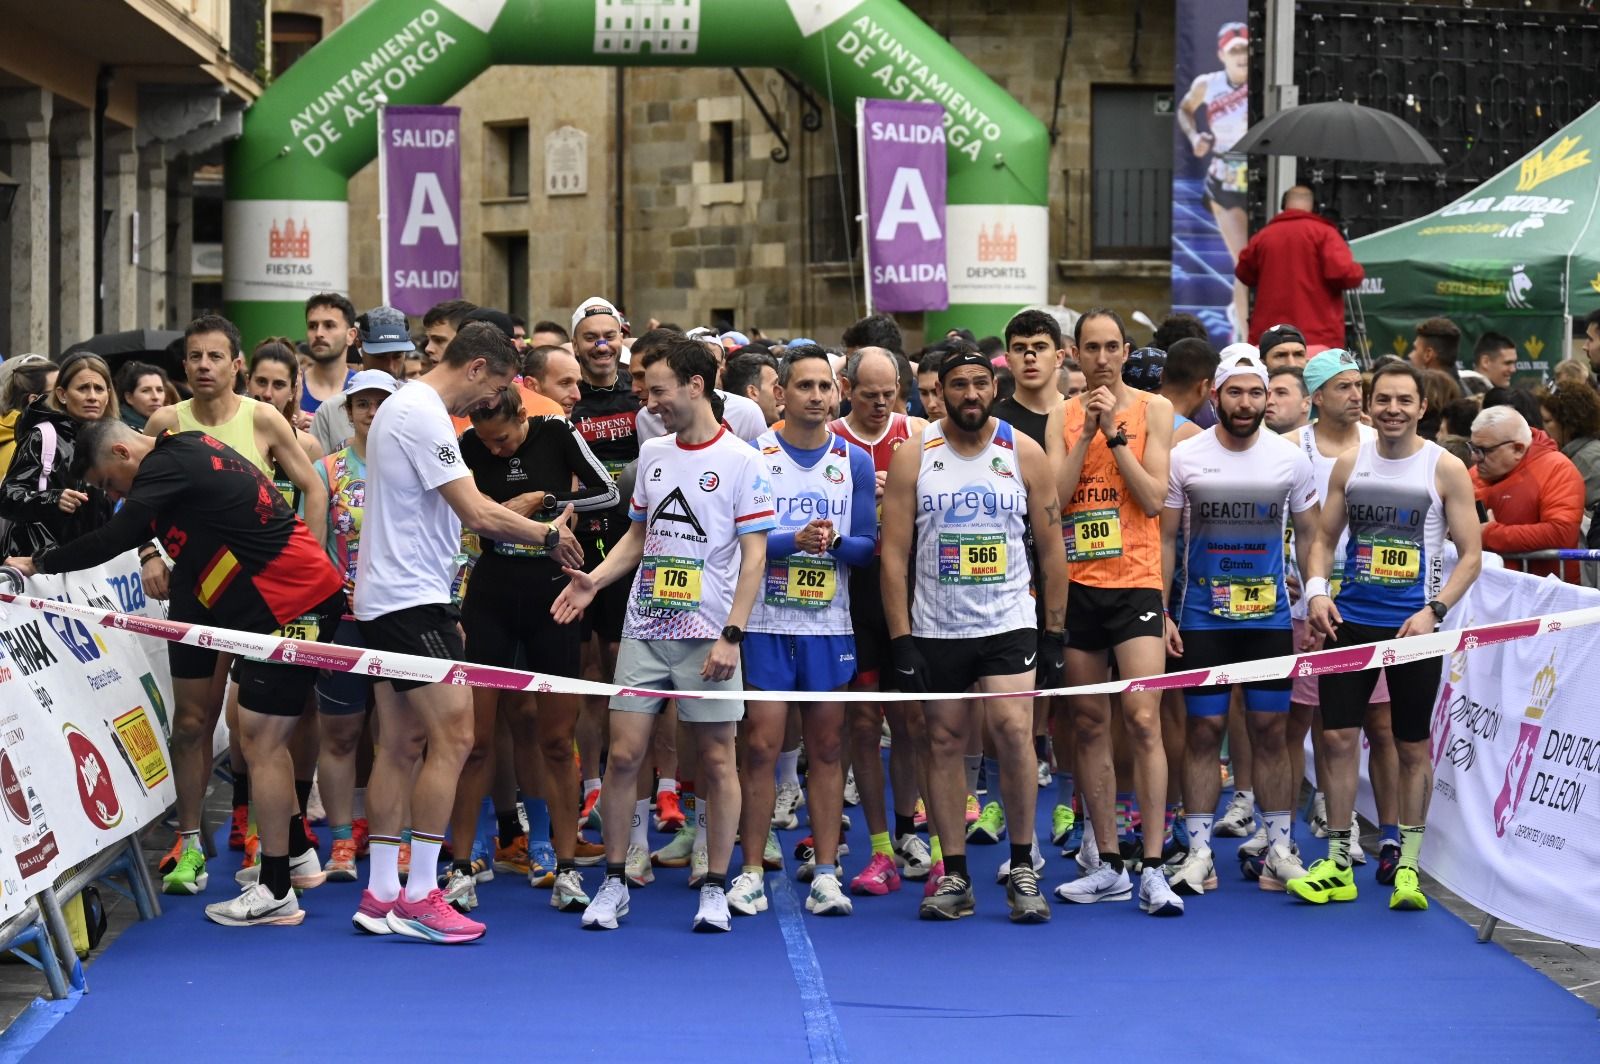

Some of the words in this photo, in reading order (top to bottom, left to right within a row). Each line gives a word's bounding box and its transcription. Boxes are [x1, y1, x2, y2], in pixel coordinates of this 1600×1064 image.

[289, 8, 440, 138] AYUNTAMIENTO
[853, 15, 1001, 142] AYUNTAMIENTO
[303, 120, 342, 158] DE
[345, 29, 457, 123] ASTORGA
[837, 31, 868, 68] DE
[872, 64, 983, 162] ASTGA
[872, 121, 946, 144] SALIDA
[401, 172, 459, 246] A
[875, 167, 942, 241] A
[266, 263, 313, 275] FIESTAS
[874, 263, 947, 285] SALIDA
[966, 267, 1026, 278] DEPORTES
[581, 416, 592, 424] LA
[582, 417, 632, 434] DESPENSA
[596, 430, 607, 439] DE
[610, 426, 633, 441] FER
[922, 490, 1020, 516] arregui
[1087, 487, 1118, 503] FLOR
[660, 529, 672, 538] CAL
[681, 533, 708, 544] ABELLA
[1082, 522, 1110, 540] 380
[968, 546, 998, 564] 566
[1381, 550, 1408, 566] 180
[664, 570, 688, 588] 176
[797, 570, 826, 588] 262
[972, 566, 998, 574] MANCHA
[800, 590, 824, 598] VICTOR
[1244, 588, 1260, 602] 74
[212, 637, 242, 648] DIPUTACIÓN
[296, 652, 326, 662] DIPUTACIÓN
[382, 667, 412, 676] DIPUTACIÓN
[1312, 663, 1342, 672] DIPUTACIÓN
[1449, 694, 1502, 742] DIPUTACIÓN
[1543, 729, 1600, 774] DIPUTACI
[1529, 771, 1554, 805] DE
[1548, 772, 1586, 814] LEÓN
[1515, 824, 1542, 844] DEPORTES
